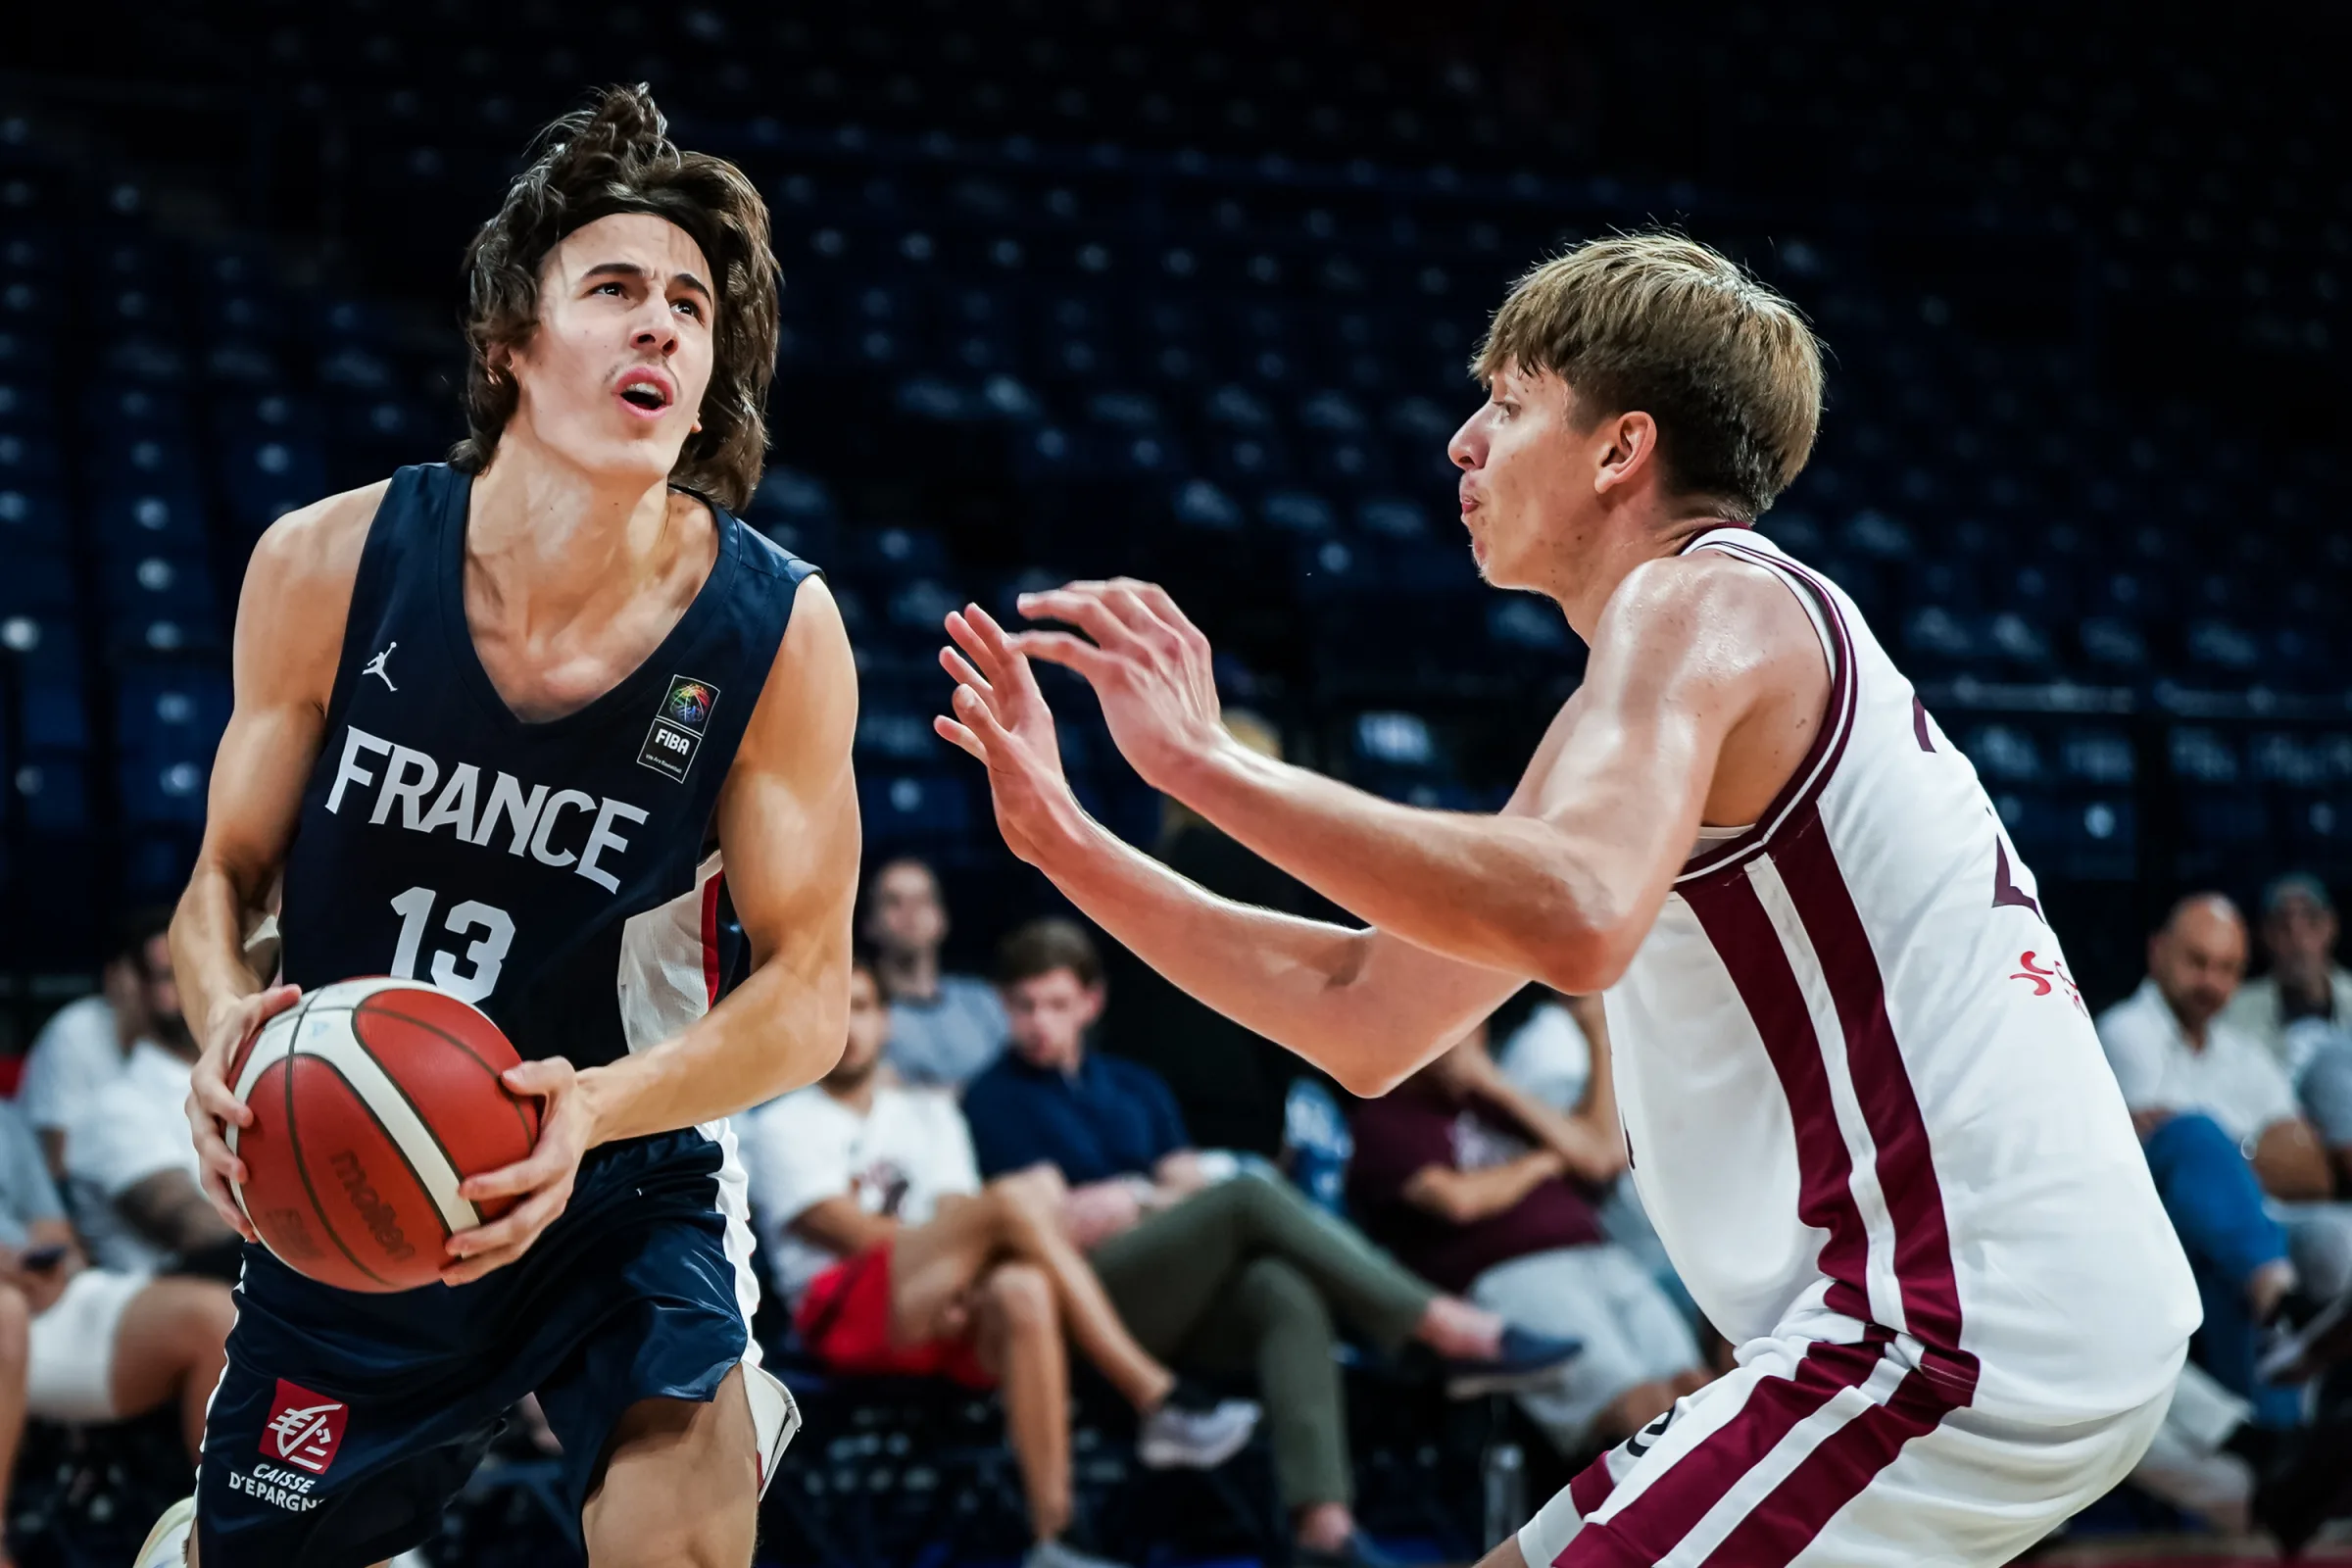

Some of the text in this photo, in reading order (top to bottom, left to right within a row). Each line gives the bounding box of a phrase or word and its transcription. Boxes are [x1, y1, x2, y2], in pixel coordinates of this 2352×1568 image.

[655, 728, 690, 756] FIBA
[325, 725, 650, 894] FRANCE
[390, 887, 515, 1004] 13
[329, 1150, 416, 1262] molten
[228, 1471, 325, 1511] D'EPARGN
[253, 1463, 316, 1494] CAISSE
